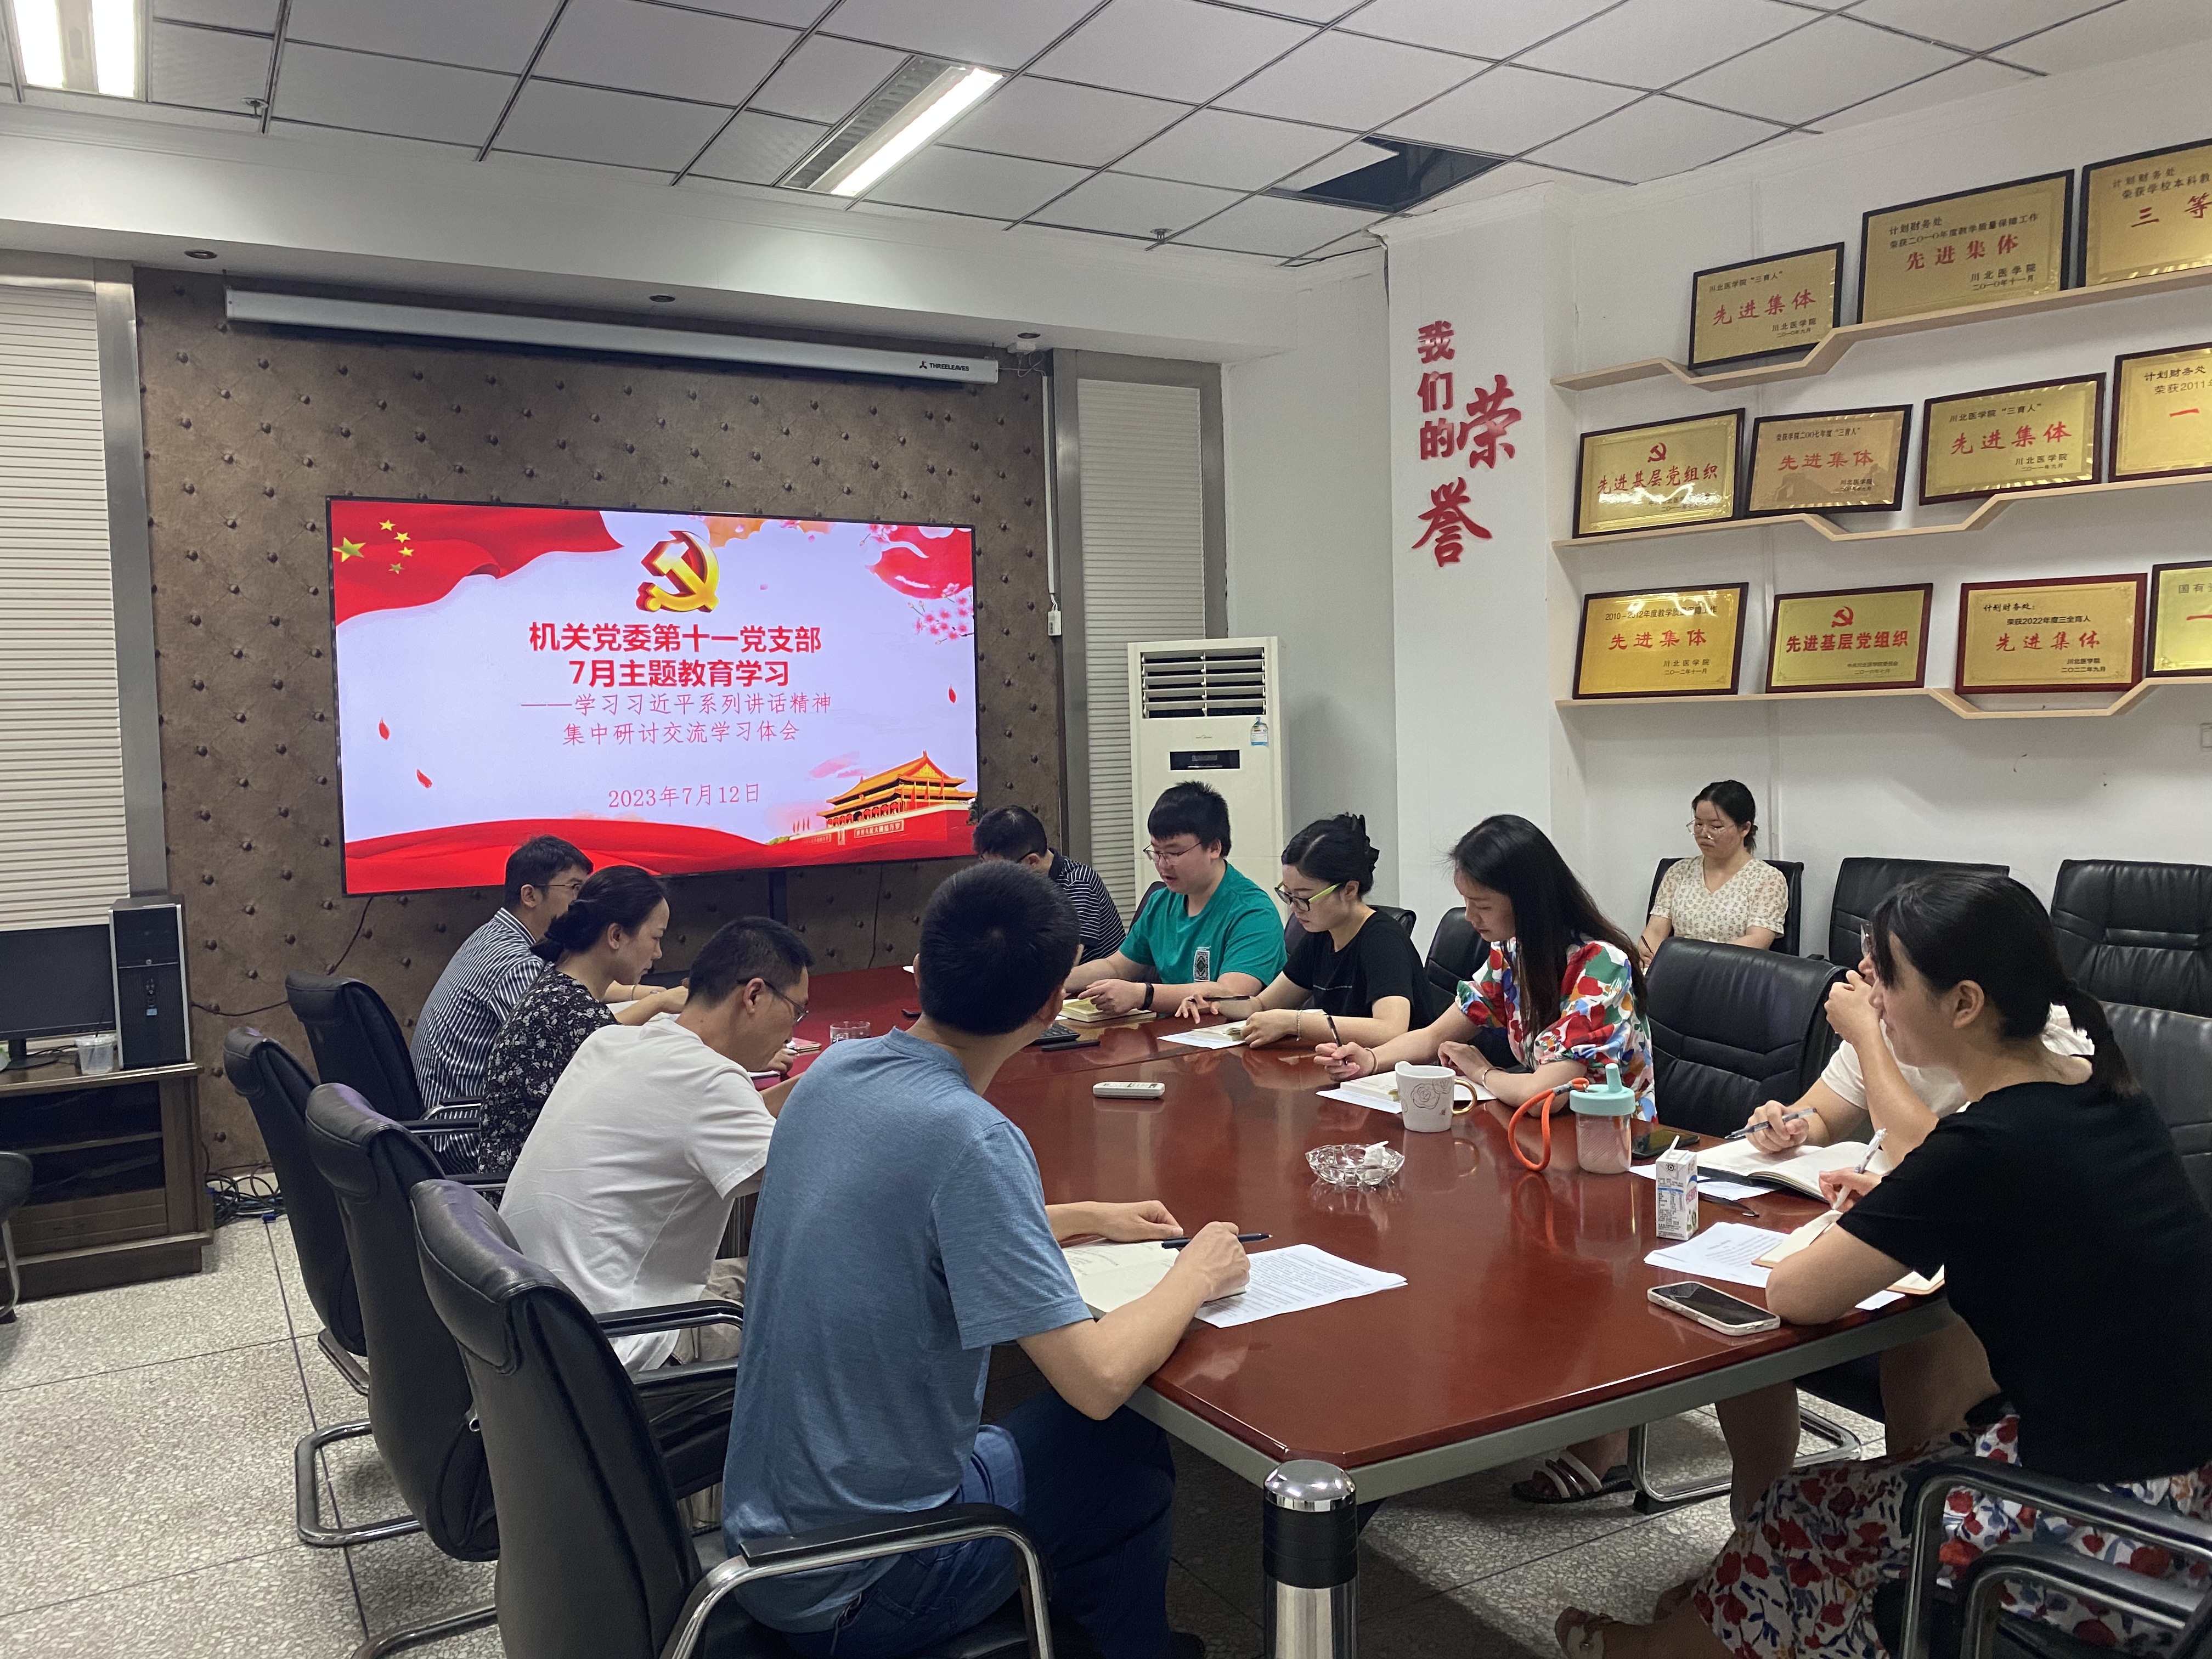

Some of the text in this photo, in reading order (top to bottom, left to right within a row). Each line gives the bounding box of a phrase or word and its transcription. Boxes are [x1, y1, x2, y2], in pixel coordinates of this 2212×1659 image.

[1888, 216, 1943, 236] 计划财务处
[1906, 233, 2019, 272] 先进集体
[1970, 263, 2036, 282] 川北医学院
[1712, 288, 1816, 326] 先进集体
[1771, 318, 1817, 332] 川北医学院
[929, 362, 970, 371] THREELEAVES
[2144, 365, 2207, 382] 计划财务处
[1950, 421, 2072, 455] 先进集体
[1777, 449, 1874, 471] 先进集体
[2015, 453, 2068, 466] 川北医学院
[1597, 462, 1719, 495] 先进基层党组织
[529, 621, 822, 654] 机关党委第十一党支部
[1608, 628, 1706, 651] 先进集体
[1786, 630, 1909, 653] 先进基层党组织
[1995, 630, 2101, 652] 先进集体
[568, 658, 789, 688] 7月主题教育学习
[1663, 658, 1710, 667] 川北医学院
[562, 719, 799, 746] 集中研讨交流学习体会
[608, 783, 759, 808] 2023年7月12日
